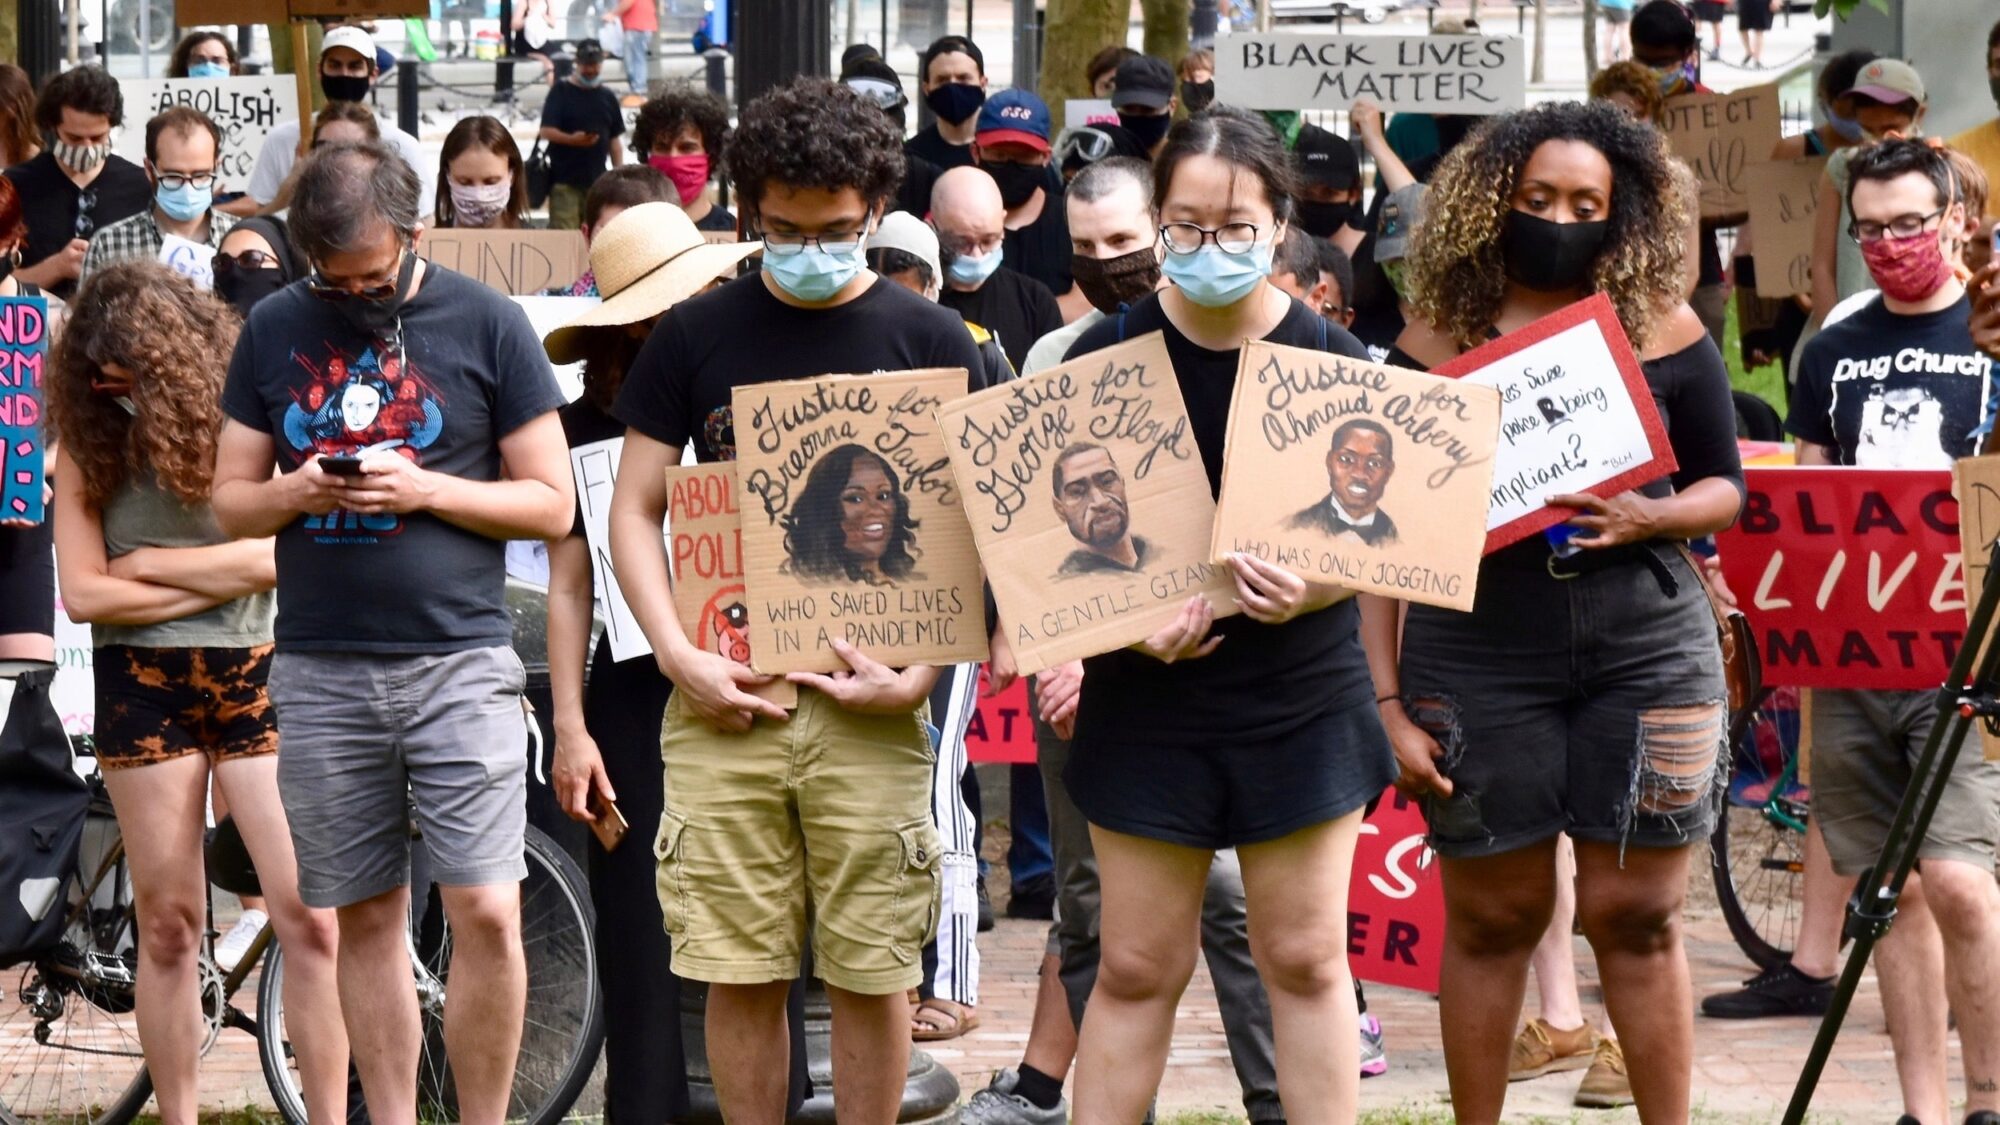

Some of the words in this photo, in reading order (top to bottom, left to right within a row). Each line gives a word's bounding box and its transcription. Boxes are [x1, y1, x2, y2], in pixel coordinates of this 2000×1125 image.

[1242, 41, 1376, 69] BLACK
[1398, 40, 1505, 69] LIVES
[1312, 70, 1500, 102] MATTER
[1257, 353, 1392, 411] Justice
[1414, 382, 1471, 421] for
[1832, 356, 1892, 382] Drug
[1895, 348, 1992, 376] Church
[752, 382, 877, 454] Justice
[958, 373, 1078, 466] Justice
[1091, 361, 1155, 405] for
[1537, 396, 1565, 424] R
[1560, 387, 1608, 413] being
[746, 420, 859, 526] Breonna
[874, 422, 958, 506] Taylor
[976, 405, 1075, 532] George
[1089, 394, 1191, 480] Floyd
[1234, 537, 1270, 560] WHO
[1277, 544, 1311, 569] WAS
[1319, 552, 1367, 580] ONLY
[1372, 562, 1462, 597] JOGGING
[767, 596, 816, 624] WHO
[830, 590, 887, 618] SAVED
[900, 586, 963, 615] LIVES
[1018, 623, 1035, 646] A
[1041, 585, 1143, 637] GENTLE
[775, 627, 800, 654] IN
[816, 626, 834, 650] A
[845, 617, 957, 649] PANDEMIC
[964, 708, 1036, 742] AT
